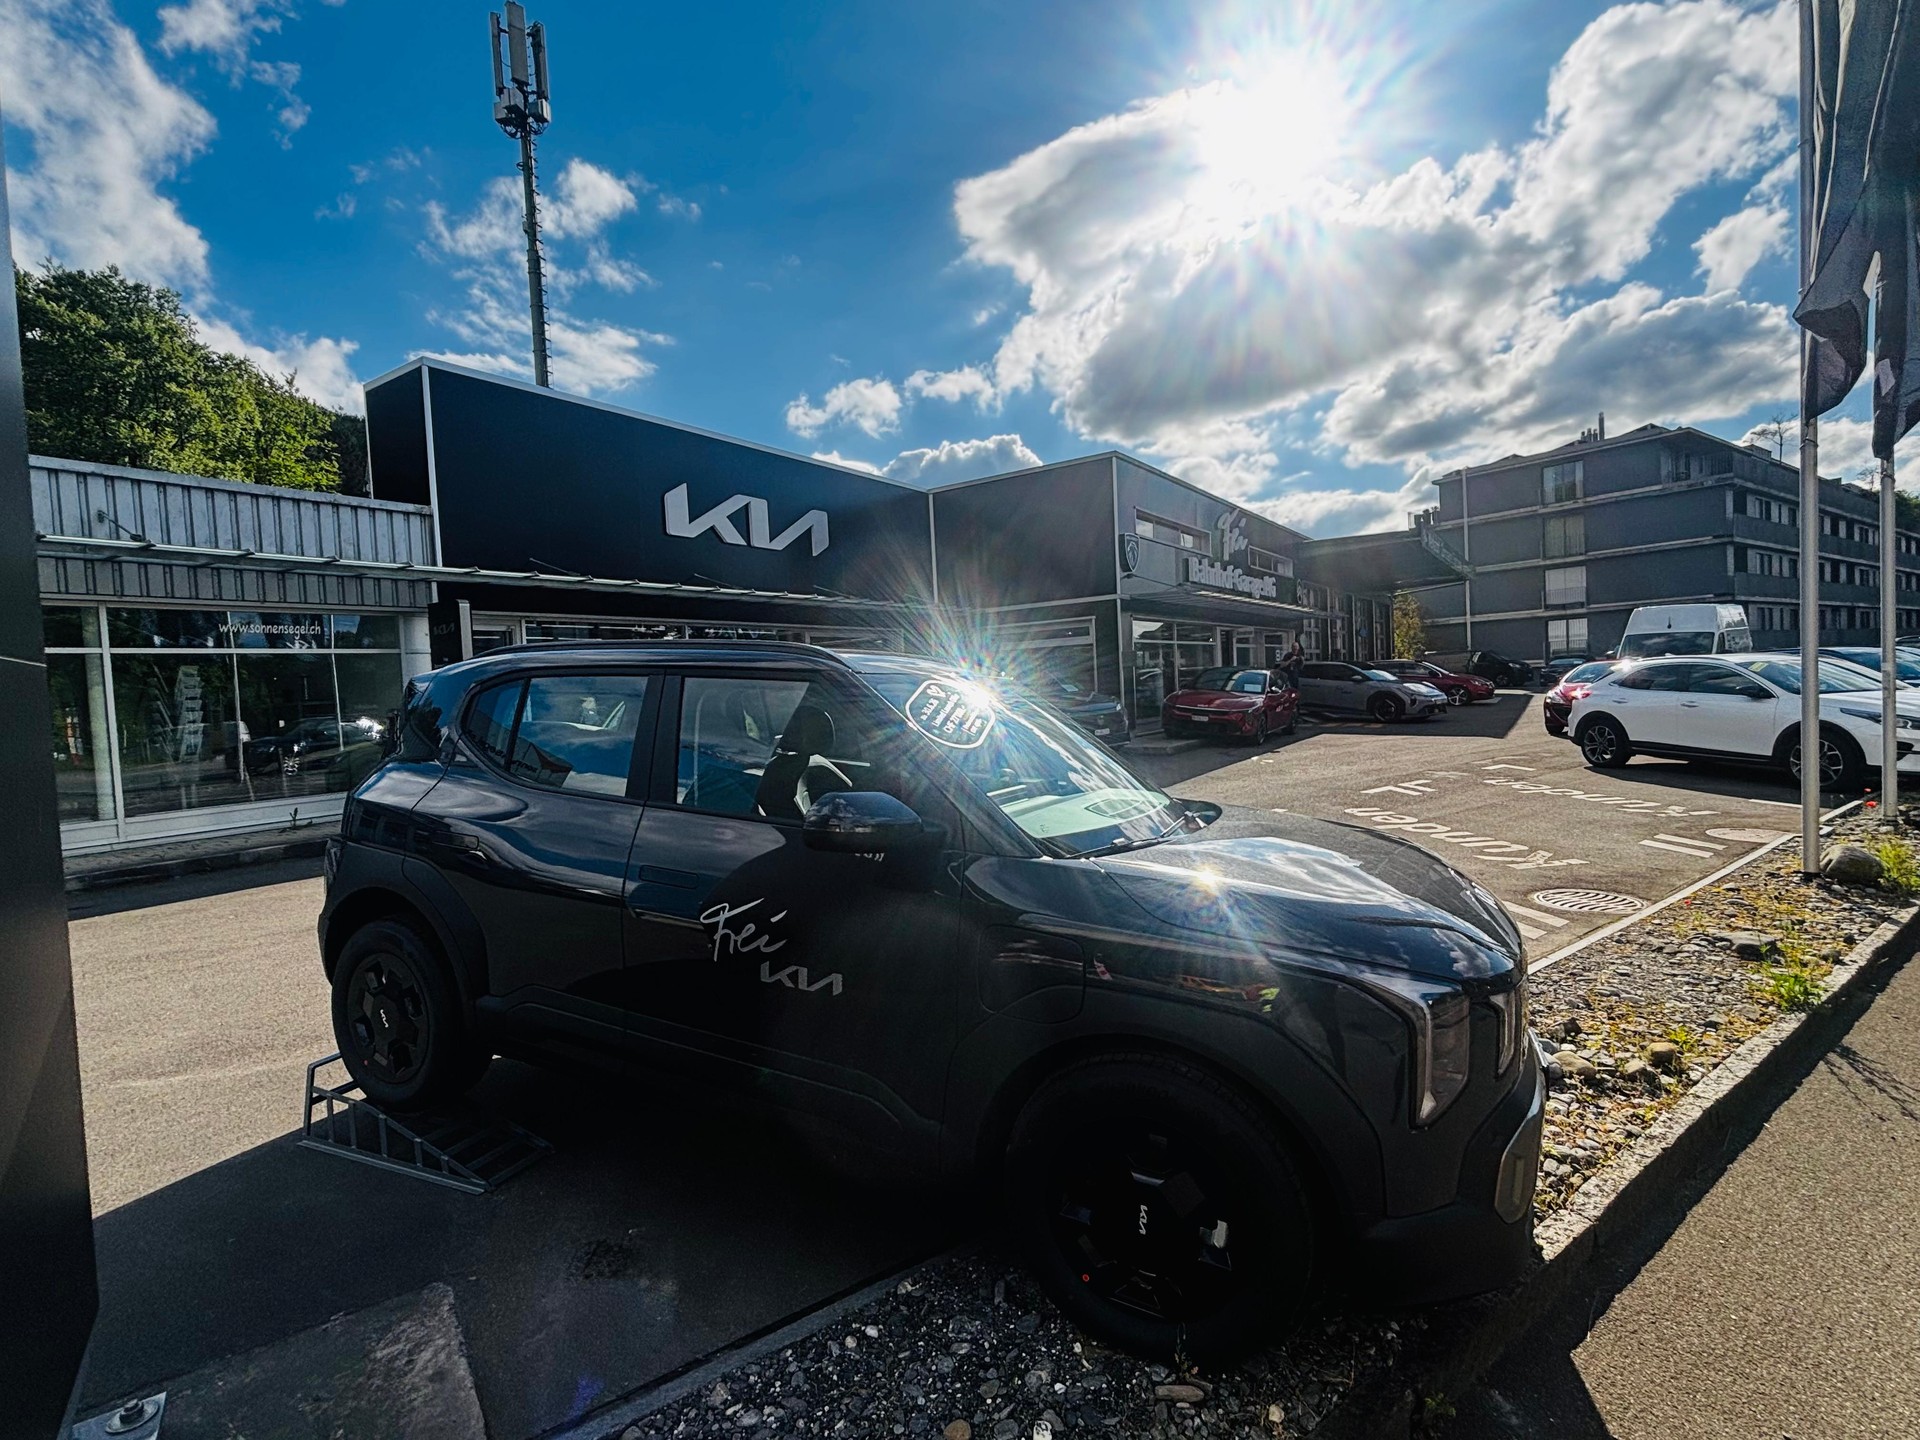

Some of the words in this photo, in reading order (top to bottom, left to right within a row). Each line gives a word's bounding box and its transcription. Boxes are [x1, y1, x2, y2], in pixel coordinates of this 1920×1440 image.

[664, 482, 829, 557] KIA
[218, 620, 321, 640] www.sonnensegel.ch
[1483, 777, 1720, 817] Kunden
[1344, 807, 1590, 869] Kunden
[760, 961, 843, 996] KIA
